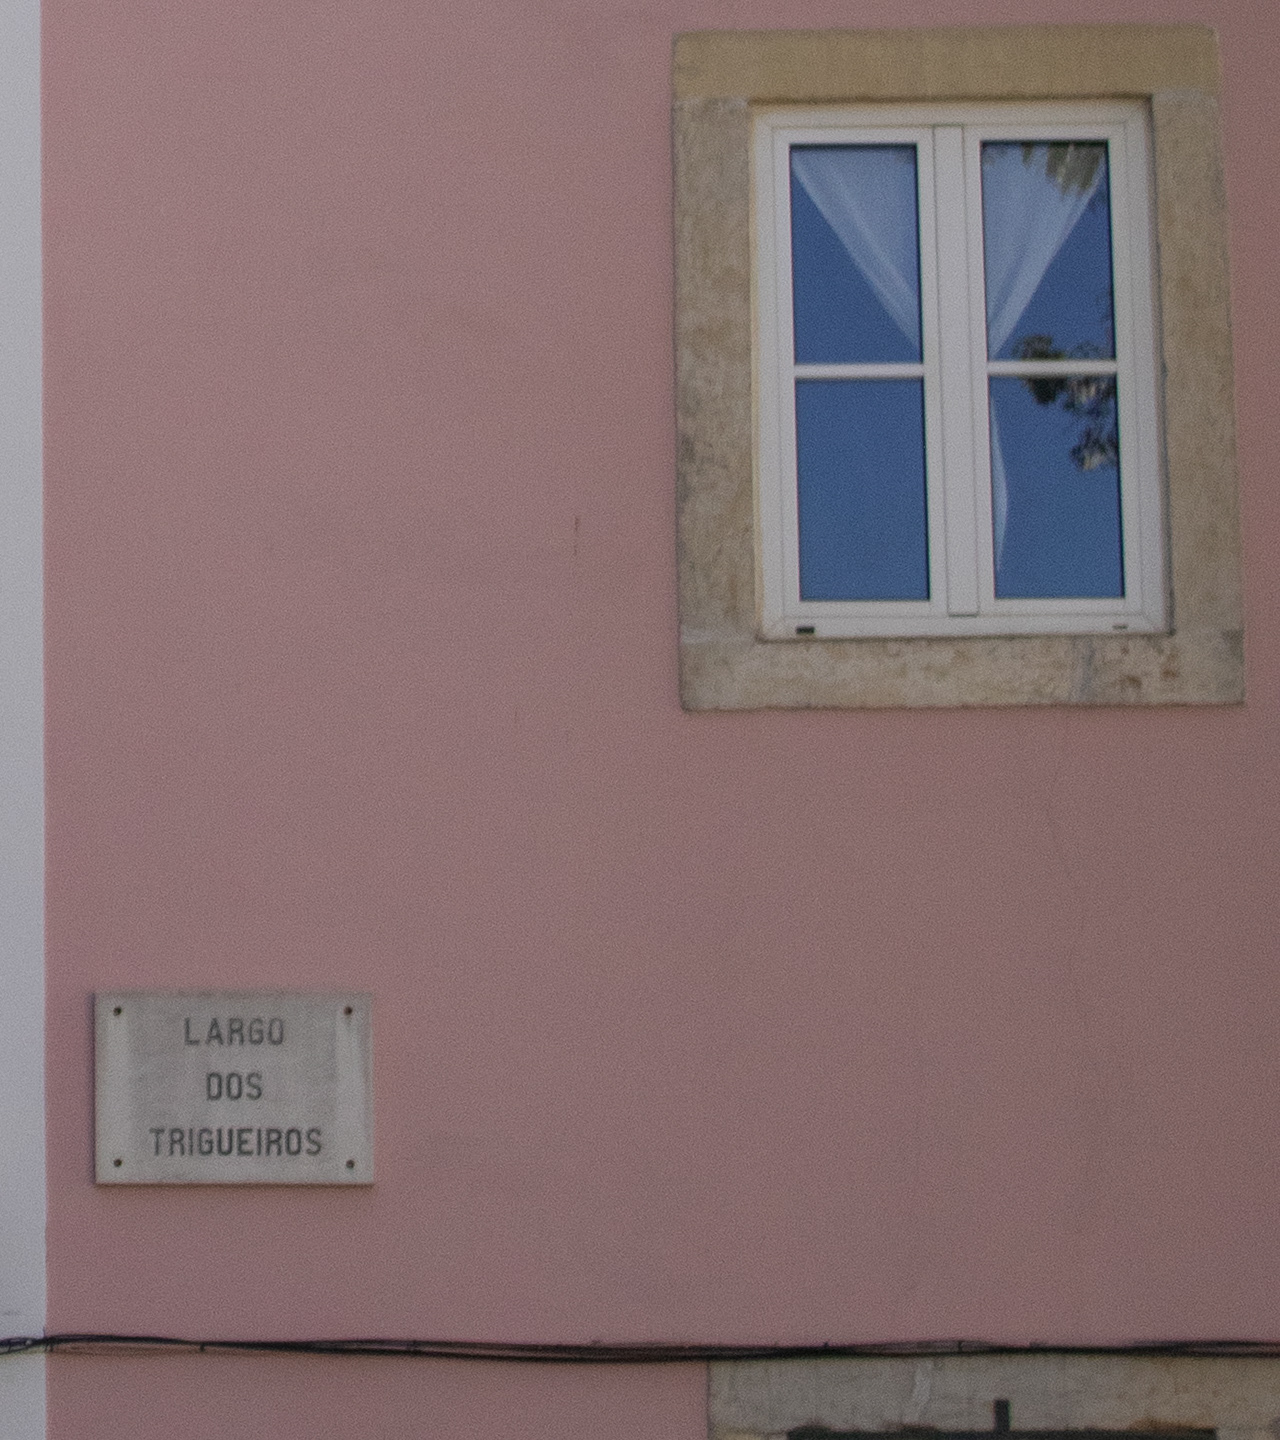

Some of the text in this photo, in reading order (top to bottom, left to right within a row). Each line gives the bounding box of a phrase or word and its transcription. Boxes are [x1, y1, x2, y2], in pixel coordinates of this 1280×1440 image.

[183, 1017, 285, 1046] LARGO
[205, 1071, 263, 1101] DOS
[148, 1127, 323, 1157] TRIGUEIROS
